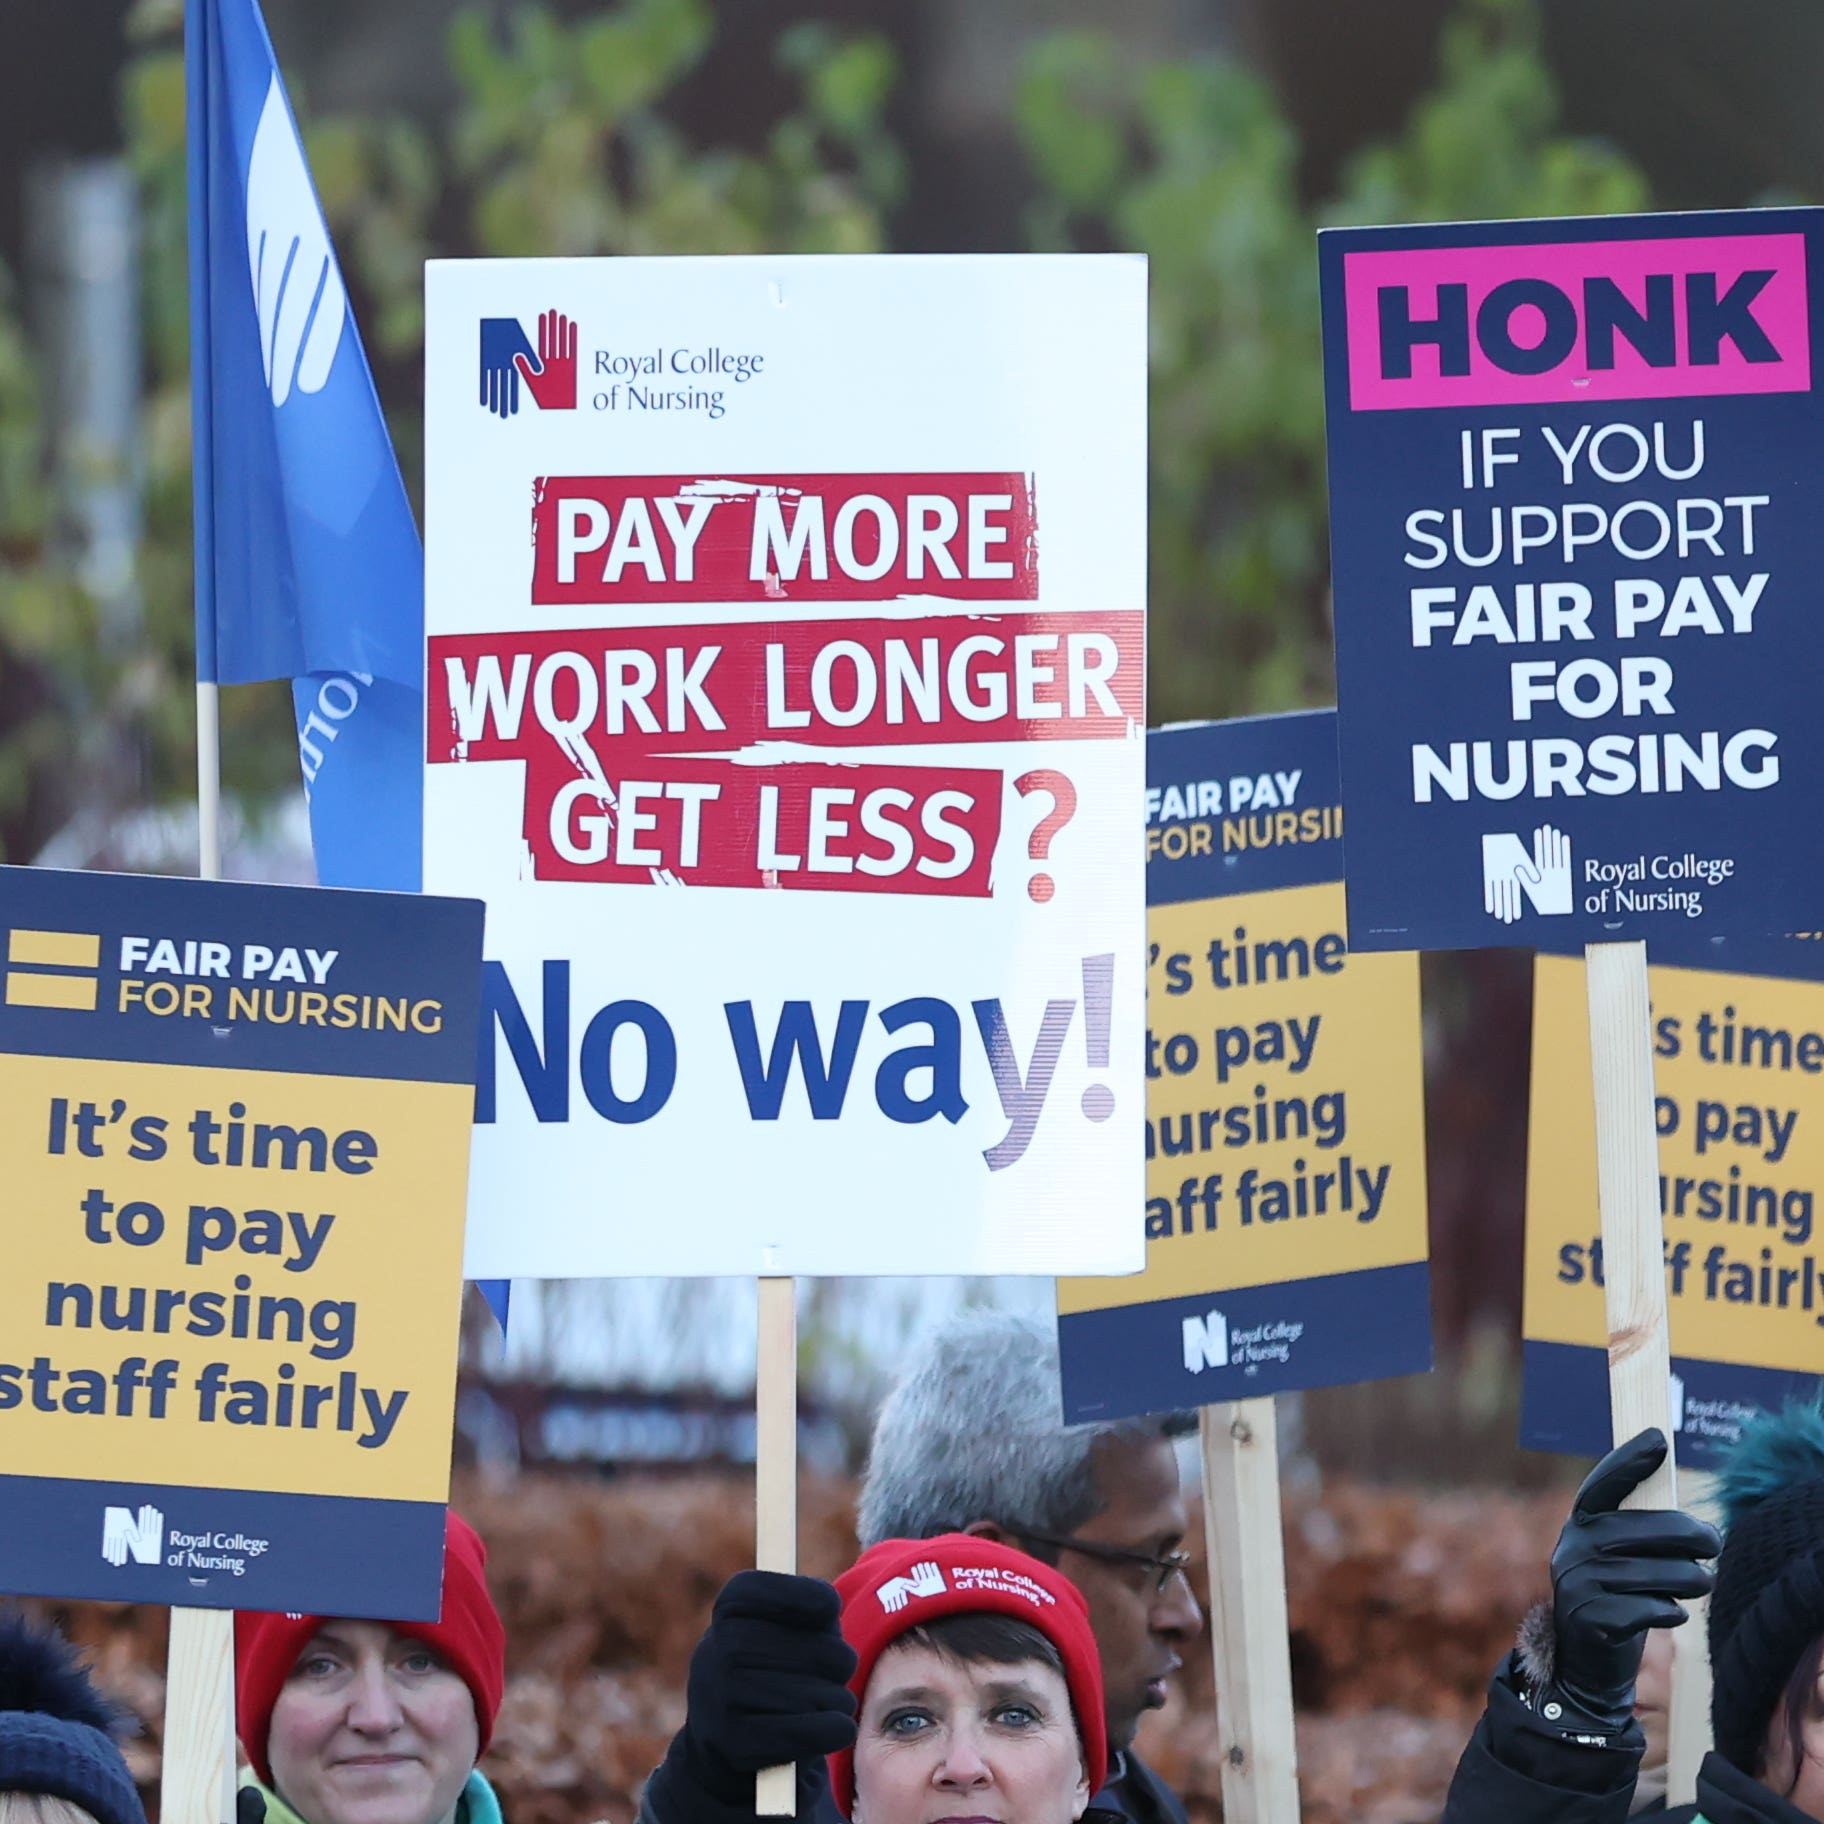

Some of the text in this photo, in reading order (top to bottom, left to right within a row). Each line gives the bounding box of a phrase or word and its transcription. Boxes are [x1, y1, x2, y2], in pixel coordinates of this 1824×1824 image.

[1377, 269, 1784, 380] HONK
[594, 347, 765, 384] Royal College
[593, 386, 725, 419] of Nursing
[1461, 420, 1705, 489] IF YOU
[556, 492, 1015, 584] PAY MORE
[1403, 494, 1771, 570] SUPPORT
[1411, 573, 1770, 648] FAIR PAY
[445, 645, 726, 742] WORK
[766, 632, 1124, 729] LONGER
[1511, 657, 1675, 721] FOR
[1145, 769, 1302, 824] FAIR PAY
[1412, 729, 1780, 803] NURSING
[549, 769, 1078, 904] GET LESS?
[1145, 804, 1343, 863] FOR NURSI
[1585, 853, 1734, 893] Royal College
[1585, 886, 1703, 918] of Nursing
[120, 936, 338, 984] FAIR PAY
[1206, 926, 1345, 990] time
[118, 980, 443, 1034] FOR NURSING
[472, 953, 1116, 1173] No way!
[1215, 1015, 1321, 1084] pay
[48, 1097, 379, 1175] It's time
[1695, 1098, 1798, 1163] pay
[80, 1189, 335, 1272] to pay
[1145, 1156, 1391, 1241] aff fairly
[45, 1273, 356, 1360] nursing
[196, 1362, 409, 1450] fairly
[168, 1550, 246, 1576] of Nursing
[169, 1531, 269, 1558] Royal College
[951, 1566, 999, 1581] Royal
